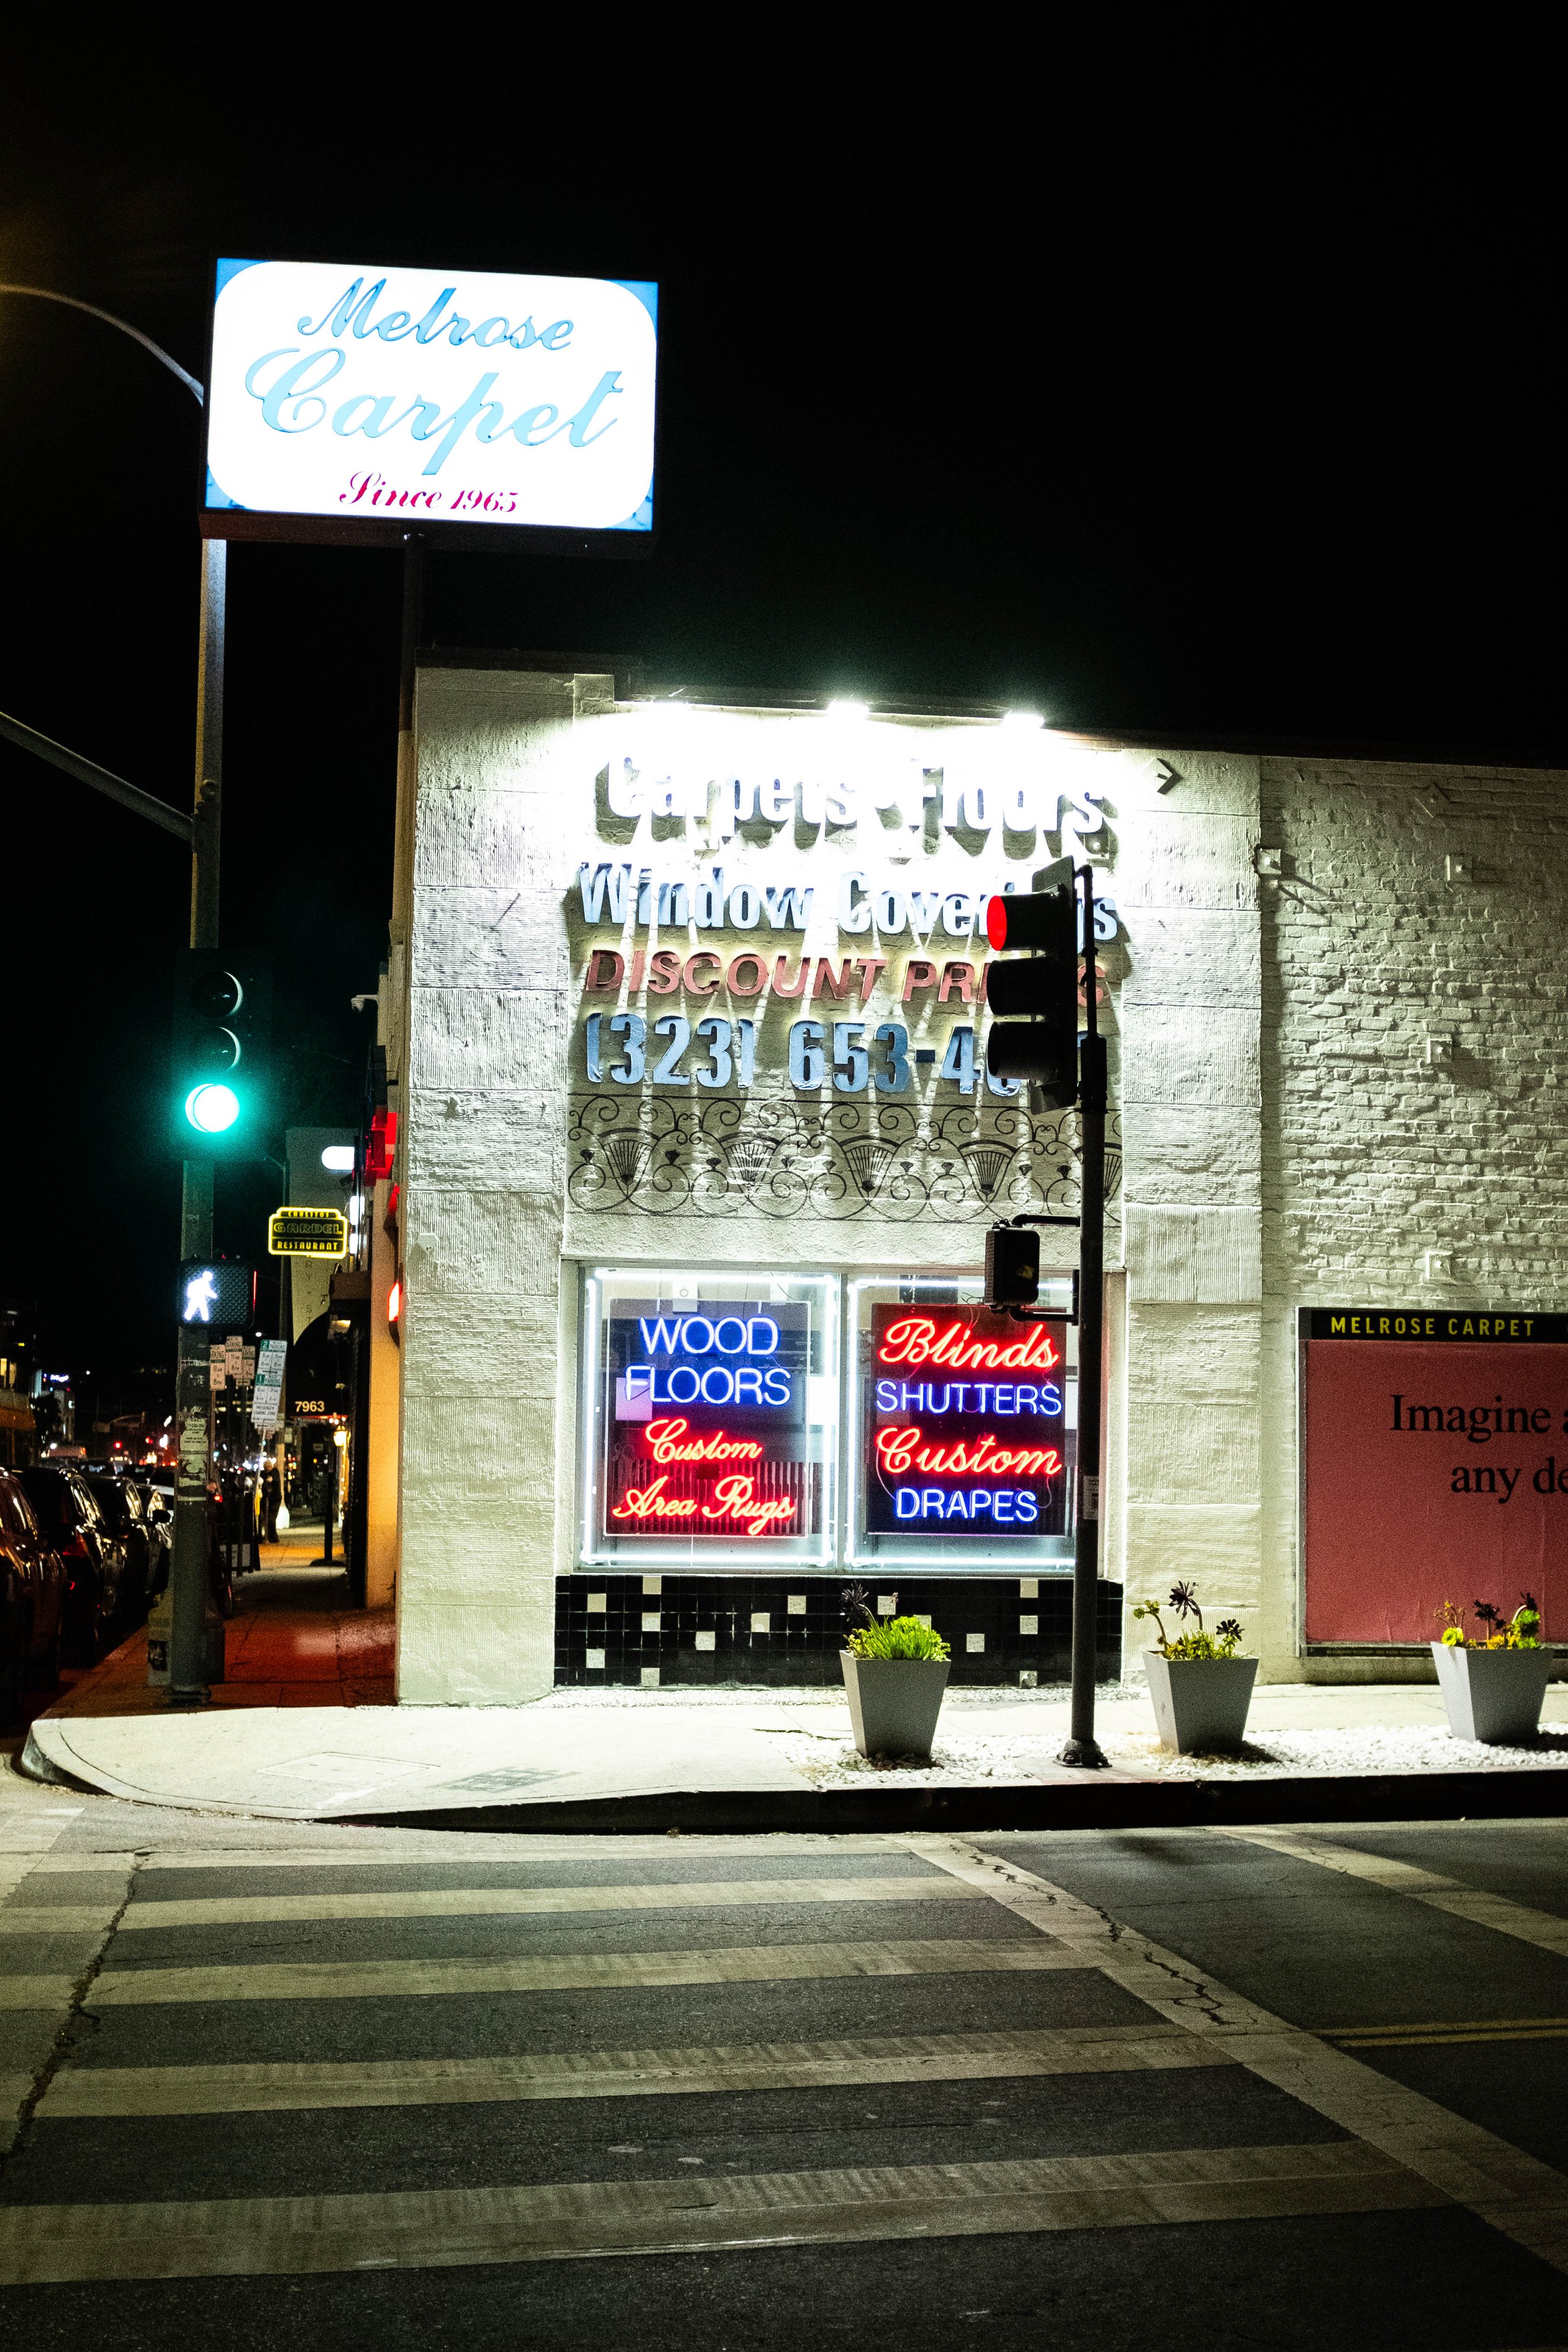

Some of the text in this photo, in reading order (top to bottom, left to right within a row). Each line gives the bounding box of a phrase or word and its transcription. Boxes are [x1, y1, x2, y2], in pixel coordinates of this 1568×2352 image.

[297, 276, 575, 351] Melrose
[245, 347, 624, 476] Carpet
[339, 470, 517, 513] Since 1965
[602, 750, 1106, 837] Carpets Floors
[579, 861, 815, 930] Window
[585, 949, 1104, 1006] DISCOUNT PRIS
[585, 1012, 755, 1088] (323)
[273, 1222, 342, 1234] GARDEL
[277, 1241, 339, 1251] RESTAURANT
[638, 1315, 780, 1356] WOOD
[878, 1317, 1059, 1370] Blinds
[1330, 1315, 1535, 1337] MELROSE CARPET
[294, 1401, 325, 1412] 7963
[625, 1365, 792, 1406] FLOORS
[875, 1380, 1064, 1417] SHUTTERS
[645, 1417, 763, 1464] Custom
[1390, 1394, 1552, 1444] Imagine
[875, 1426, 1064, 1476] Custom
[612, 1474, 796, 1537] Area Rugs
[896, 1487, 1039, 1523] DRAPES
[1451, 1467, 1522, 1505] any
